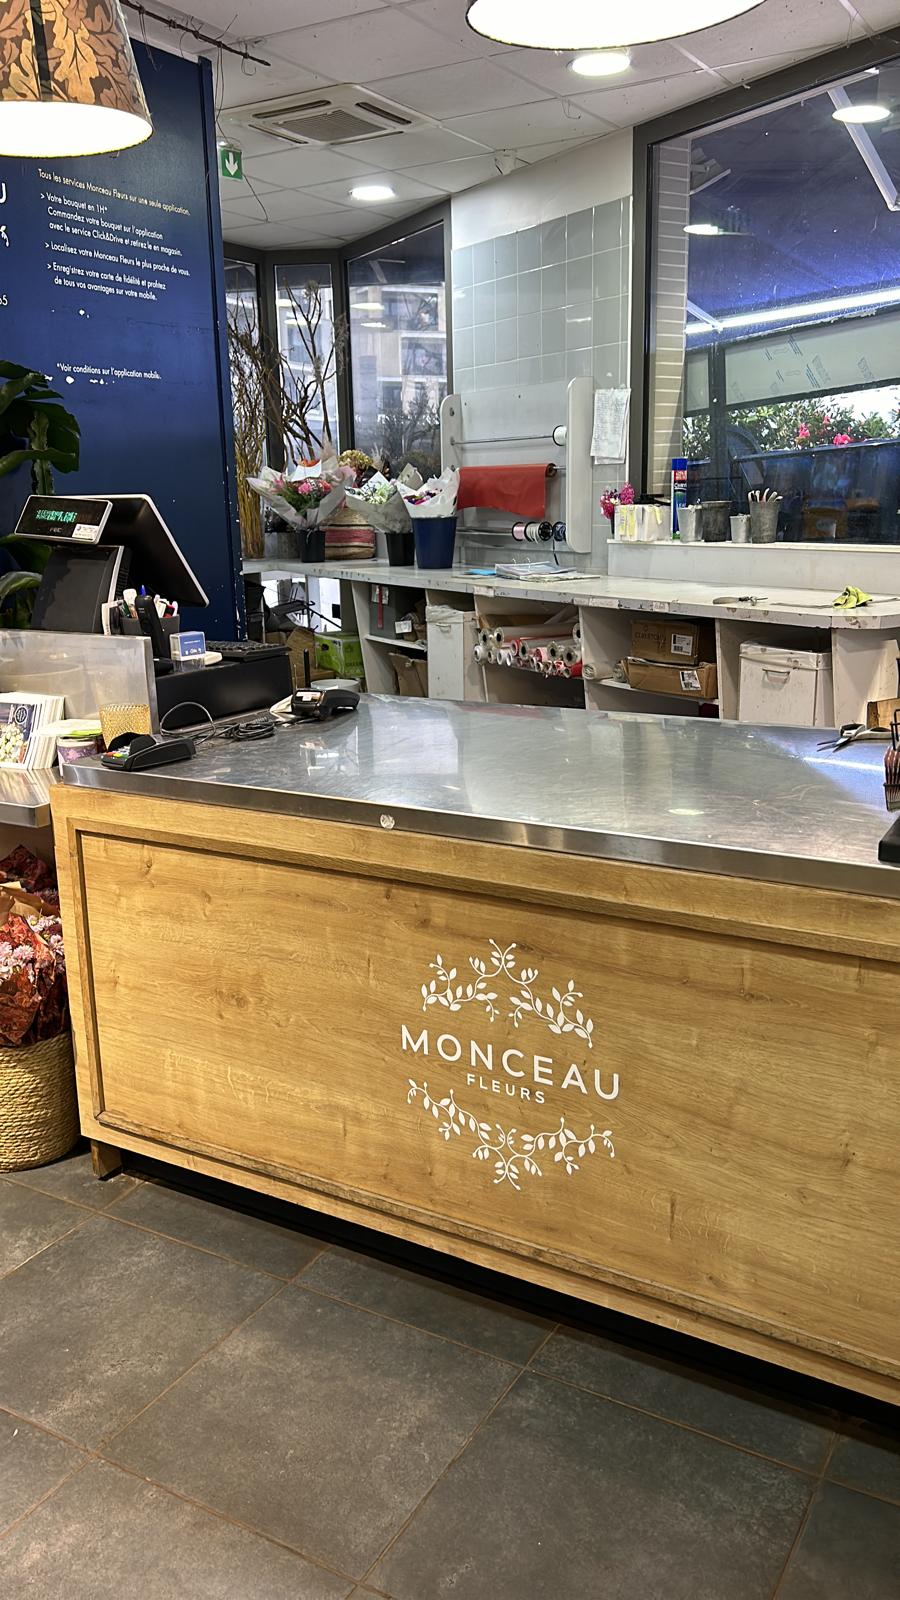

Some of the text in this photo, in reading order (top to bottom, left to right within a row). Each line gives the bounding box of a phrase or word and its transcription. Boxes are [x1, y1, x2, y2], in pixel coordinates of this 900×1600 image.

[38, 168, 52, 180] Tous
[53, 171, 61, 183] les
[63, 178, 85, 189] services
[86, 182, 112, 196] Monceau
[113, 188, 128, 200] Fleurs
[149, 200, 162, 208] seule
[46, 192, 62, 204] Votre
[63, 195, 87, 210] bouquet
[47, 206, 85, 222] Commandez
[86, 217, 100, 226] votre
[100, 218, 123, 231] bouquet
[49, 222, 63, 231] avec
[64, 222, 71, 232] le
[71, 227, 92, 237] service
[153, 244, 160, 252] en
[51, 241, 78, 254] Localisez
[78, 249, 93, 257] votre
[93, 249, 119, 262] Monceau
[119, 254, 135, 267] Fleurs
[135, 257, 141, 267] le
[141, 259, 152, 269] plus
[152, 263, 170, 272] proche
[170, 264, 178, 274] de
[54, 275, 63, 285] de
[63, 278, 75, 287] tous
[76, 281, 86, 289] vos
[87, 283, 115, 294] avantages
[116, 287, 124, 295] sur
[124, 289, 138, 297] votre
[85, 270, 100, 278] votre
[100, 272, 115, 281] carte
[115, 272, 123, 282] de
[141, 279, 147, 287] et
[147, 279, 167, 290] profitez
[72, 364, 101, 375] conditions
[401, 1024, 619, 1100] MONCEAU
[467, 1073, 545, 1104] FLEURS
